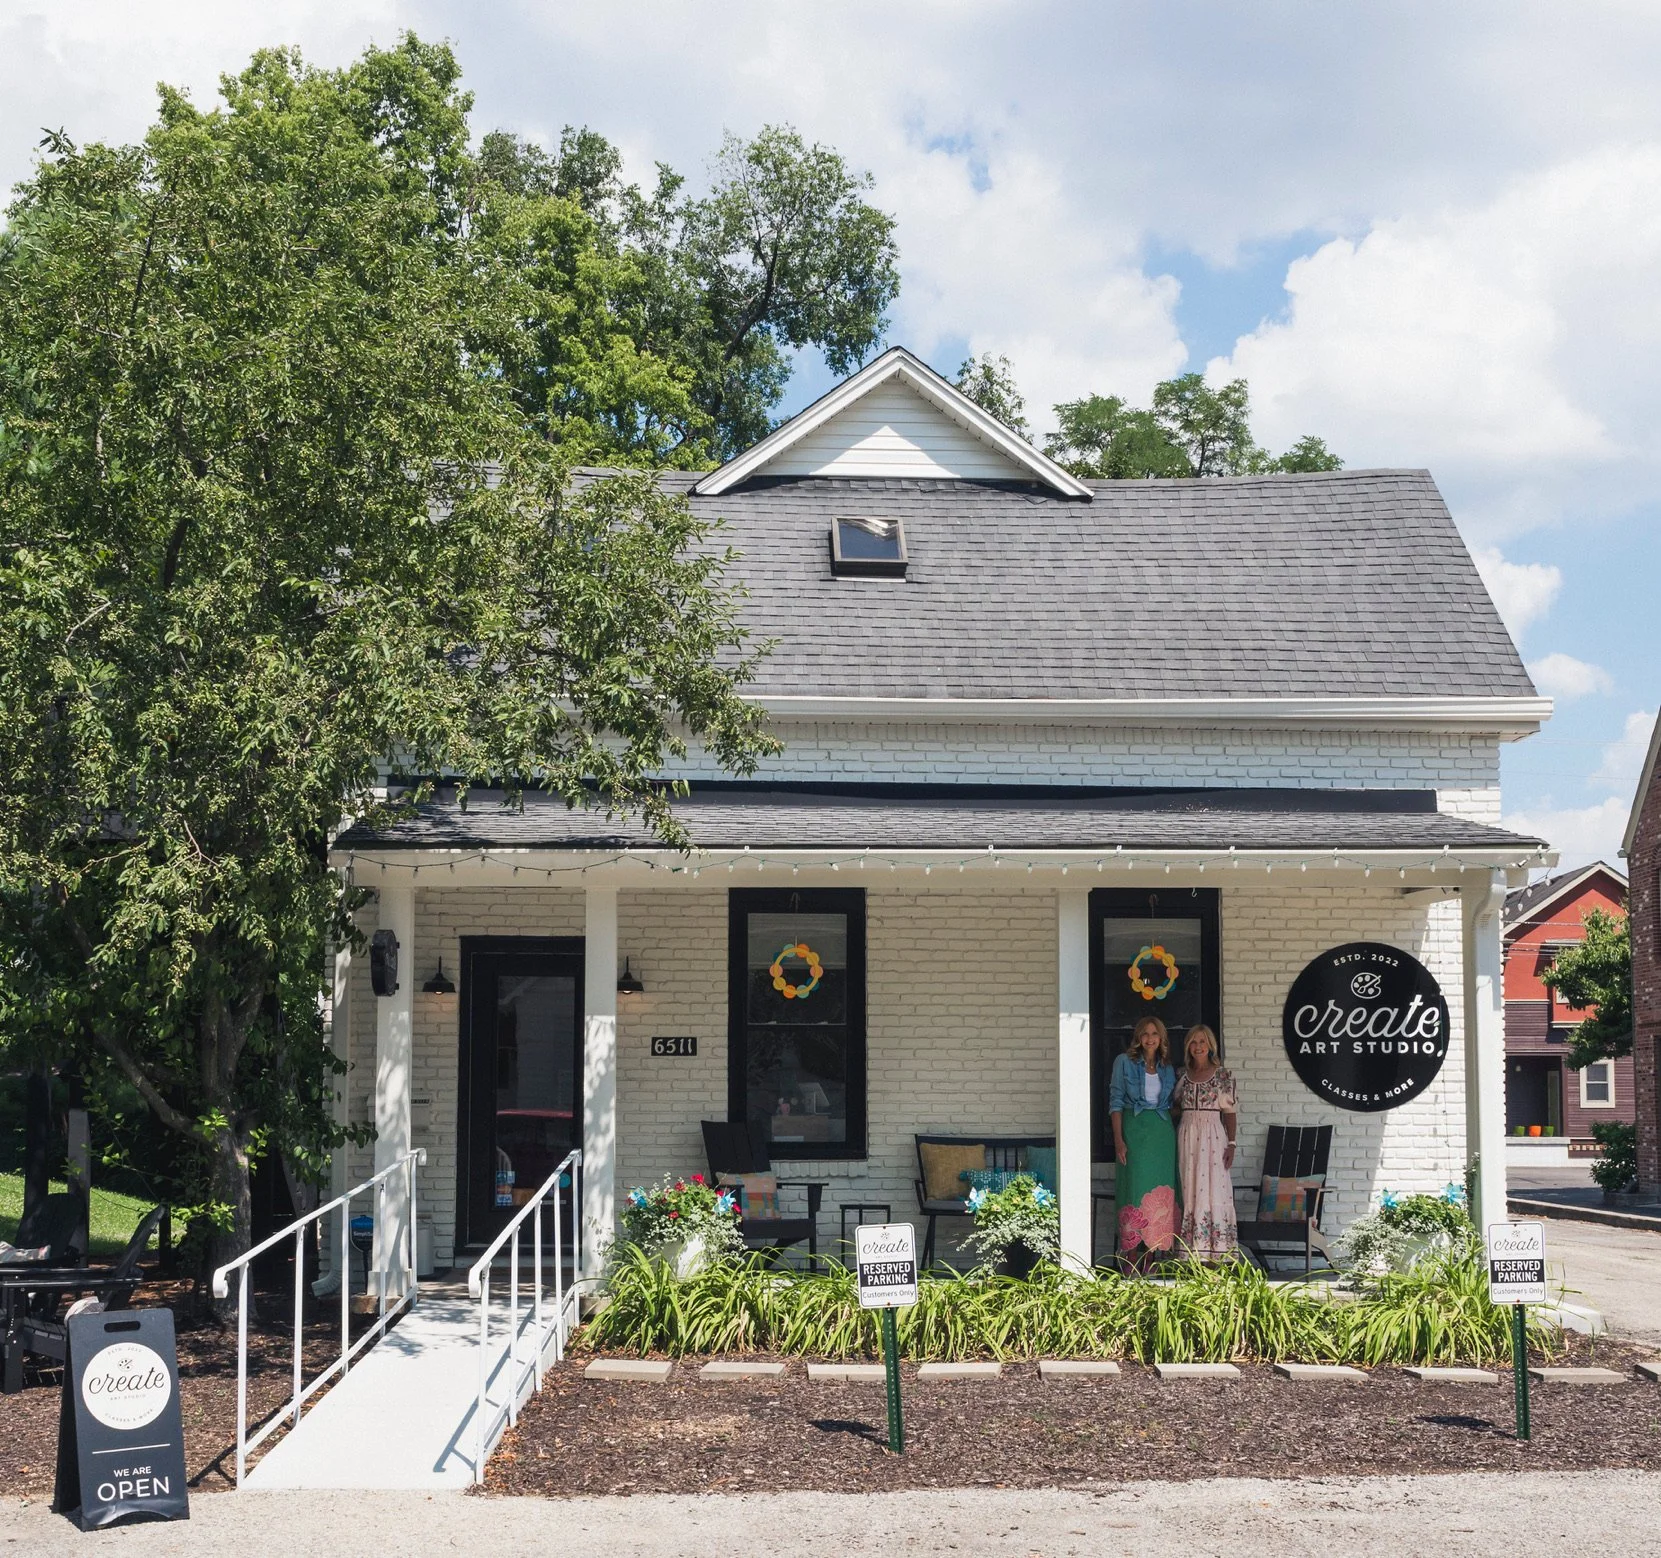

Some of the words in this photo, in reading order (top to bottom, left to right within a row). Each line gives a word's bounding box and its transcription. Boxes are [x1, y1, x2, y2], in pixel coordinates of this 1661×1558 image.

[1333, 953, 1366, 967] ESTD.
[1371, 953, 1399, 967] 2022
[1294, 994, 1440, 1038] create
[654, 1038, 693, 1054] 6511
[1299, 1041, 1340, 1054] ART
[1353, 1041, 1435, 1054] STUDIO
[1321, 1078, 1368, 1101] CLASSES
[1373, 1092, 1380, 1101] &
[1385, 1077, 1415, 1099] MORE
[863, 1238, 909, 1254] create
[1494, 1237, 1539, 1251] create
[863, 1262, 911, 1275] RESERVED
[1494, 1260, 1541, 1272] RESERVED
[867, 1273, 909, 1286] PARKING
[1498, 1271, 1538, 1282] PARKING
[862, 1290, 898, 1299] Customers
[899, 1289, 915, 1297] Only
[1529, 1287, 1543, 1295] Only
[88, 1366, 165, 1395] create
[114, 1468, 130, 1478] WE
[132, 1465, 152, 1476] ARE
[97, 1475, 170, 1502] OPEN
